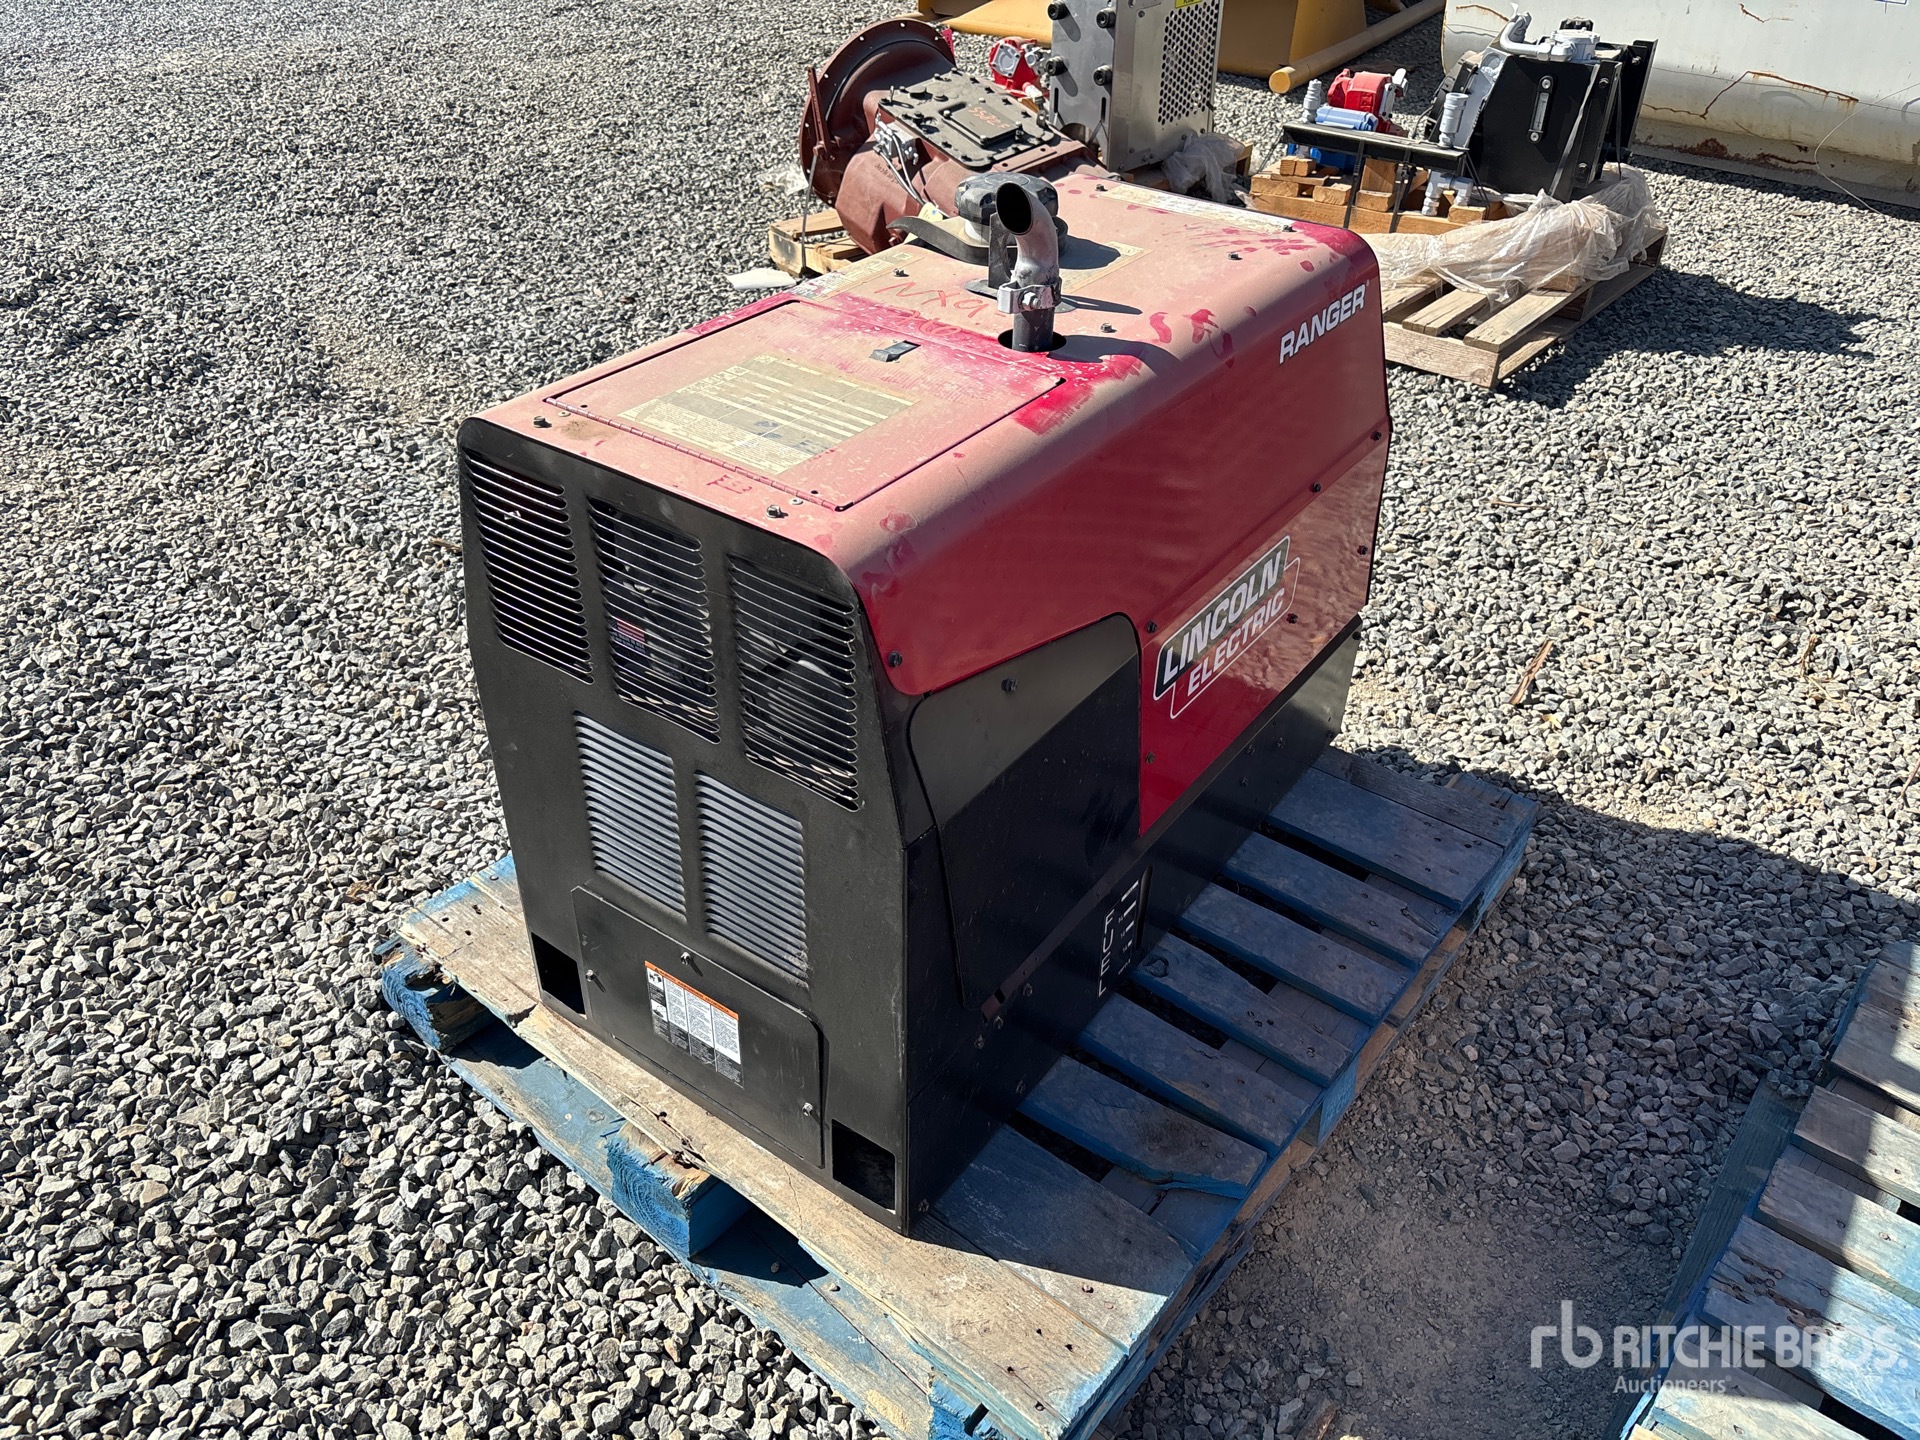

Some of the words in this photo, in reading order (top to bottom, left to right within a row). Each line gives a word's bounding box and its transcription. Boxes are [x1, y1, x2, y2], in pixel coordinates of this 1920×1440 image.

[1163, 550, 1282, 686] LINCOLN
[1187, 587, 1285, 698] ELECTRIC
[1098, 908, 1115, 997] FUEL
